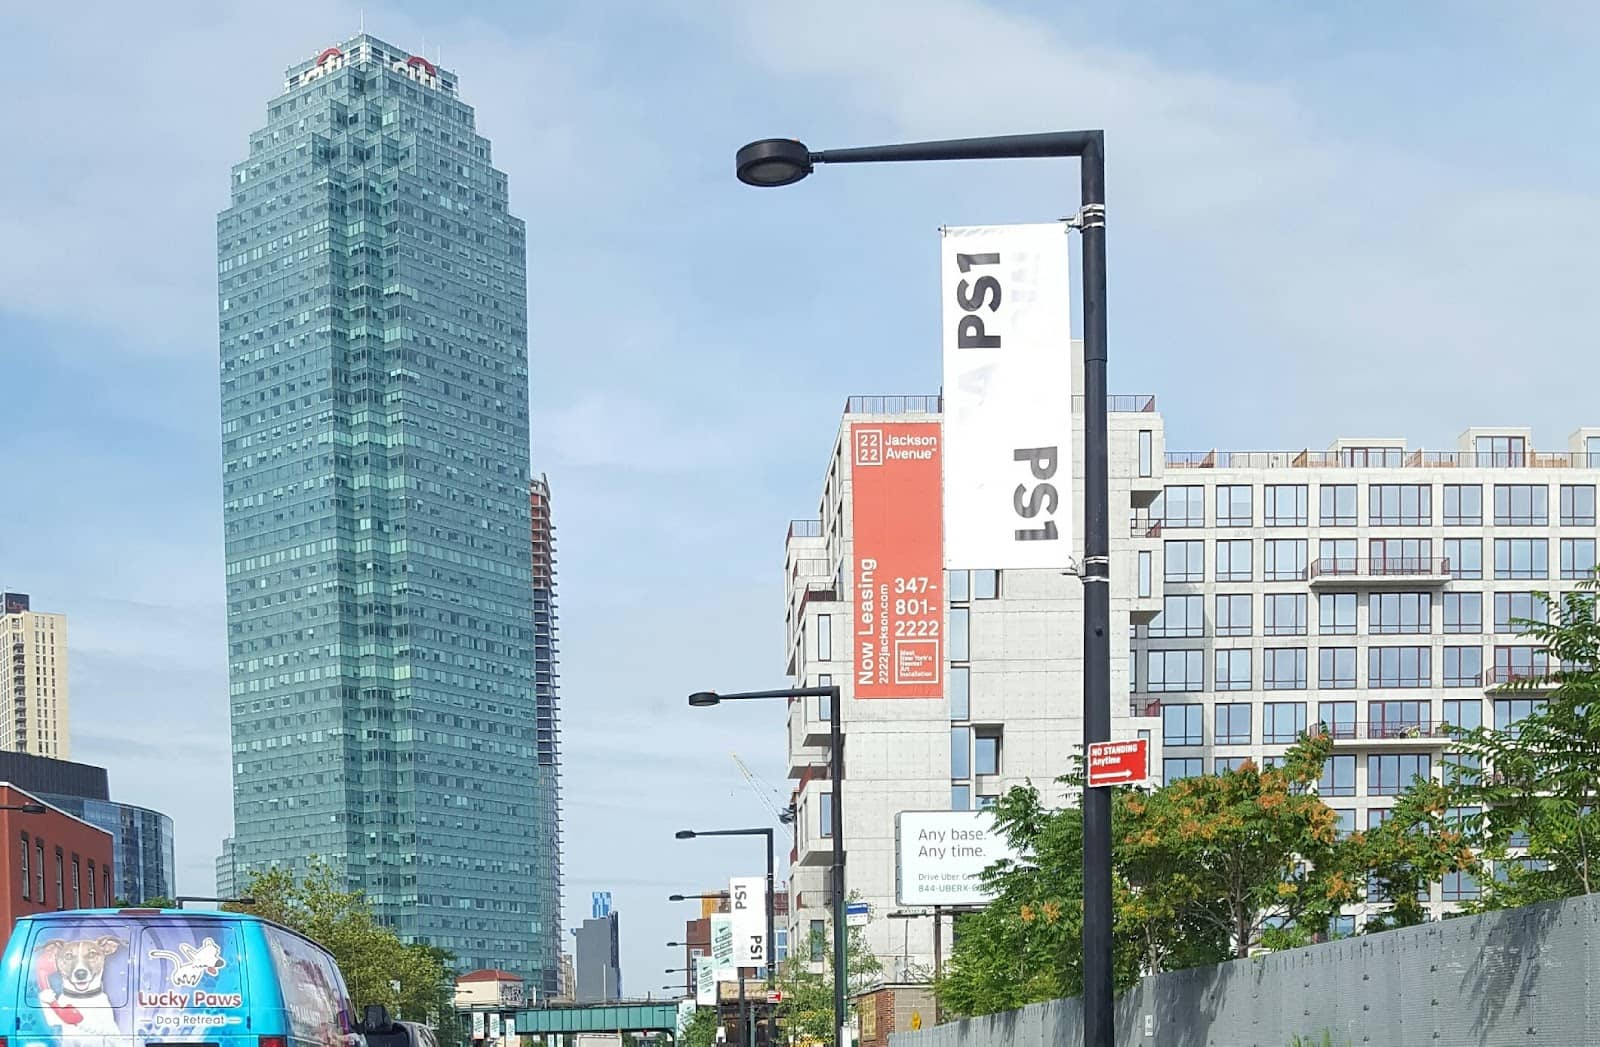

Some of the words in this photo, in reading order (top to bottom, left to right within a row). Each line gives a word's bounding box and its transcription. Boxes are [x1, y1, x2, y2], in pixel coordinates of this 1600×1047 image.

[956, 252, 1001, 349] PS1
[860, 434, 878, 447] 22
[885, 434, 937, 446] Jackson
[860, 448, 878, 461] 22
[1013, 446, 1059, 541] PS1
[895, 577, 937, 594] 347-
[858, 558, 877, 635] Leasing
[895, 599, 937, 615] 801-
[879, 583, 890, 684] 2222jackson.com
[895, 620, 939, 636] 2222
[858, 642, 874, 685] Now
[1091, 747, 1103, 756] NO
[1103, 743, 1138, 755] STANDING
[1092, 756, 1121, 767] Anytime
[918, 828, 946, 843] Any
[951, 828, 987, 841] base.
[918, 845, 946, 860] Any
[951, 844, 987, 857] time.
[918, 873, 939, 881] Drive
[734, 885, 747, 910] PS1
[750, 935, 763, 960] PS1
[138, 991, 188, 1009] Lucky
[195, 992, 241, 1007] Paws
[156, 1015, 180, 1027] Dog
[183, 1015, 225, 1025] Retreat
